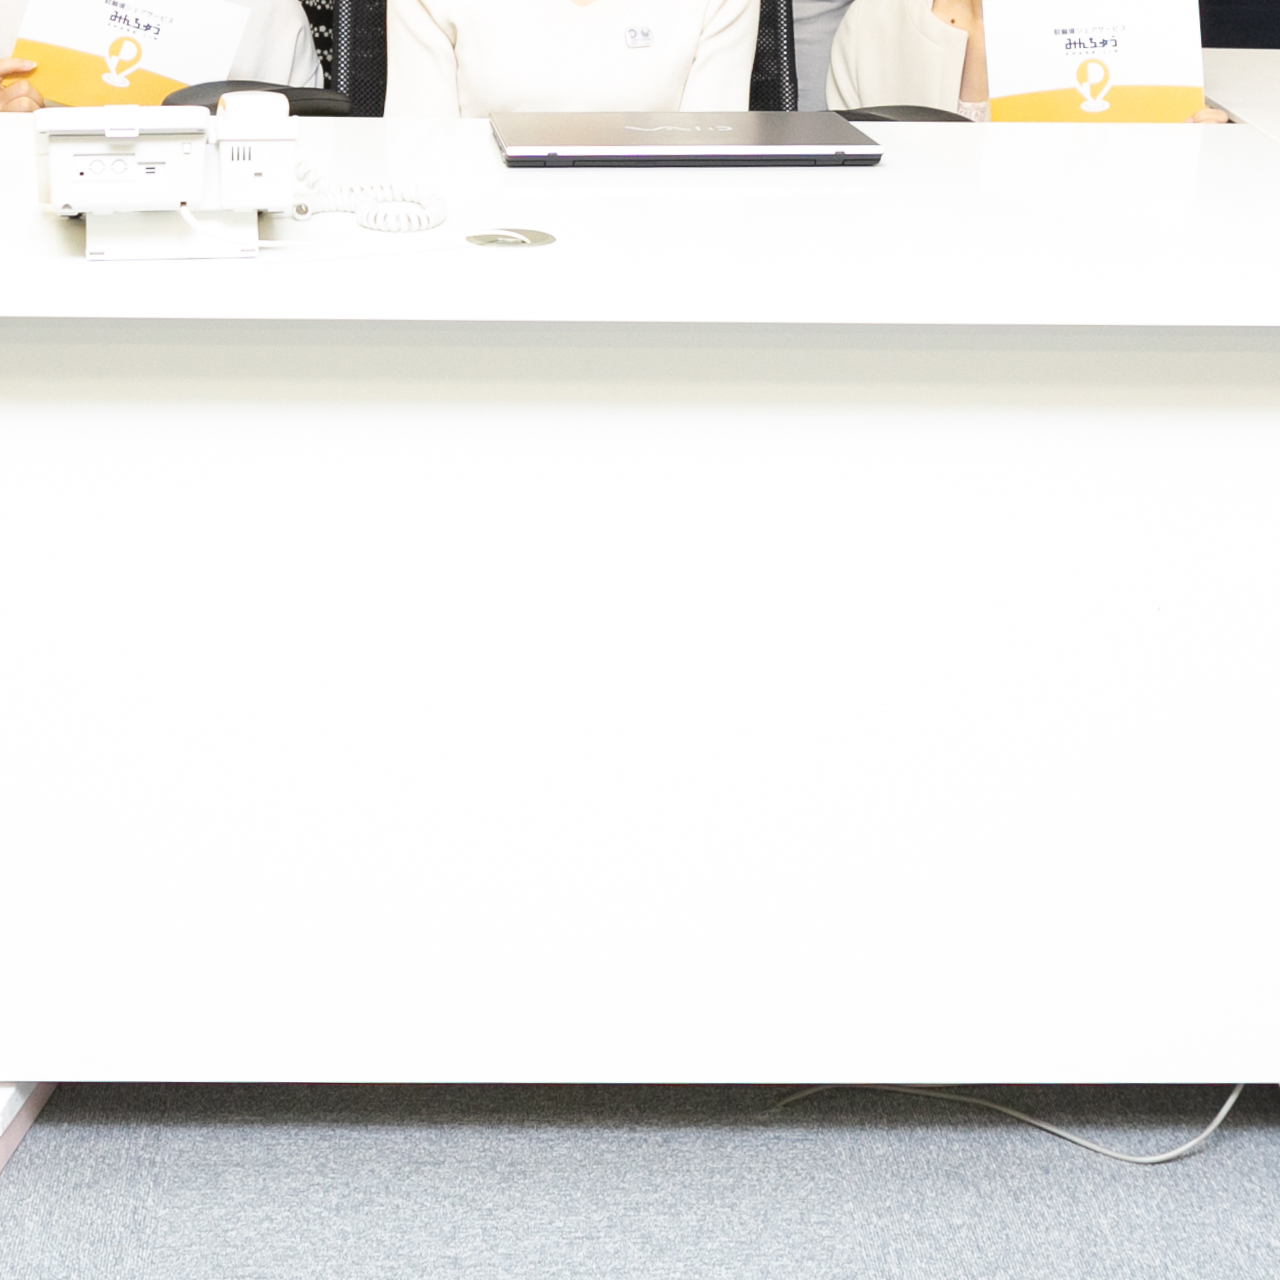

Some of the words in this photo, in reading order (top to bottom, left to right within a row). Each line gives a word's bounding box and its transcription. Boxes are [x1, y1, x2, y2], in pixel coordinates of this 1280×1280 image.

[109, 10, 161, 35] みんちゅう
[1065, 35, 1117, 50] みんちゅう
